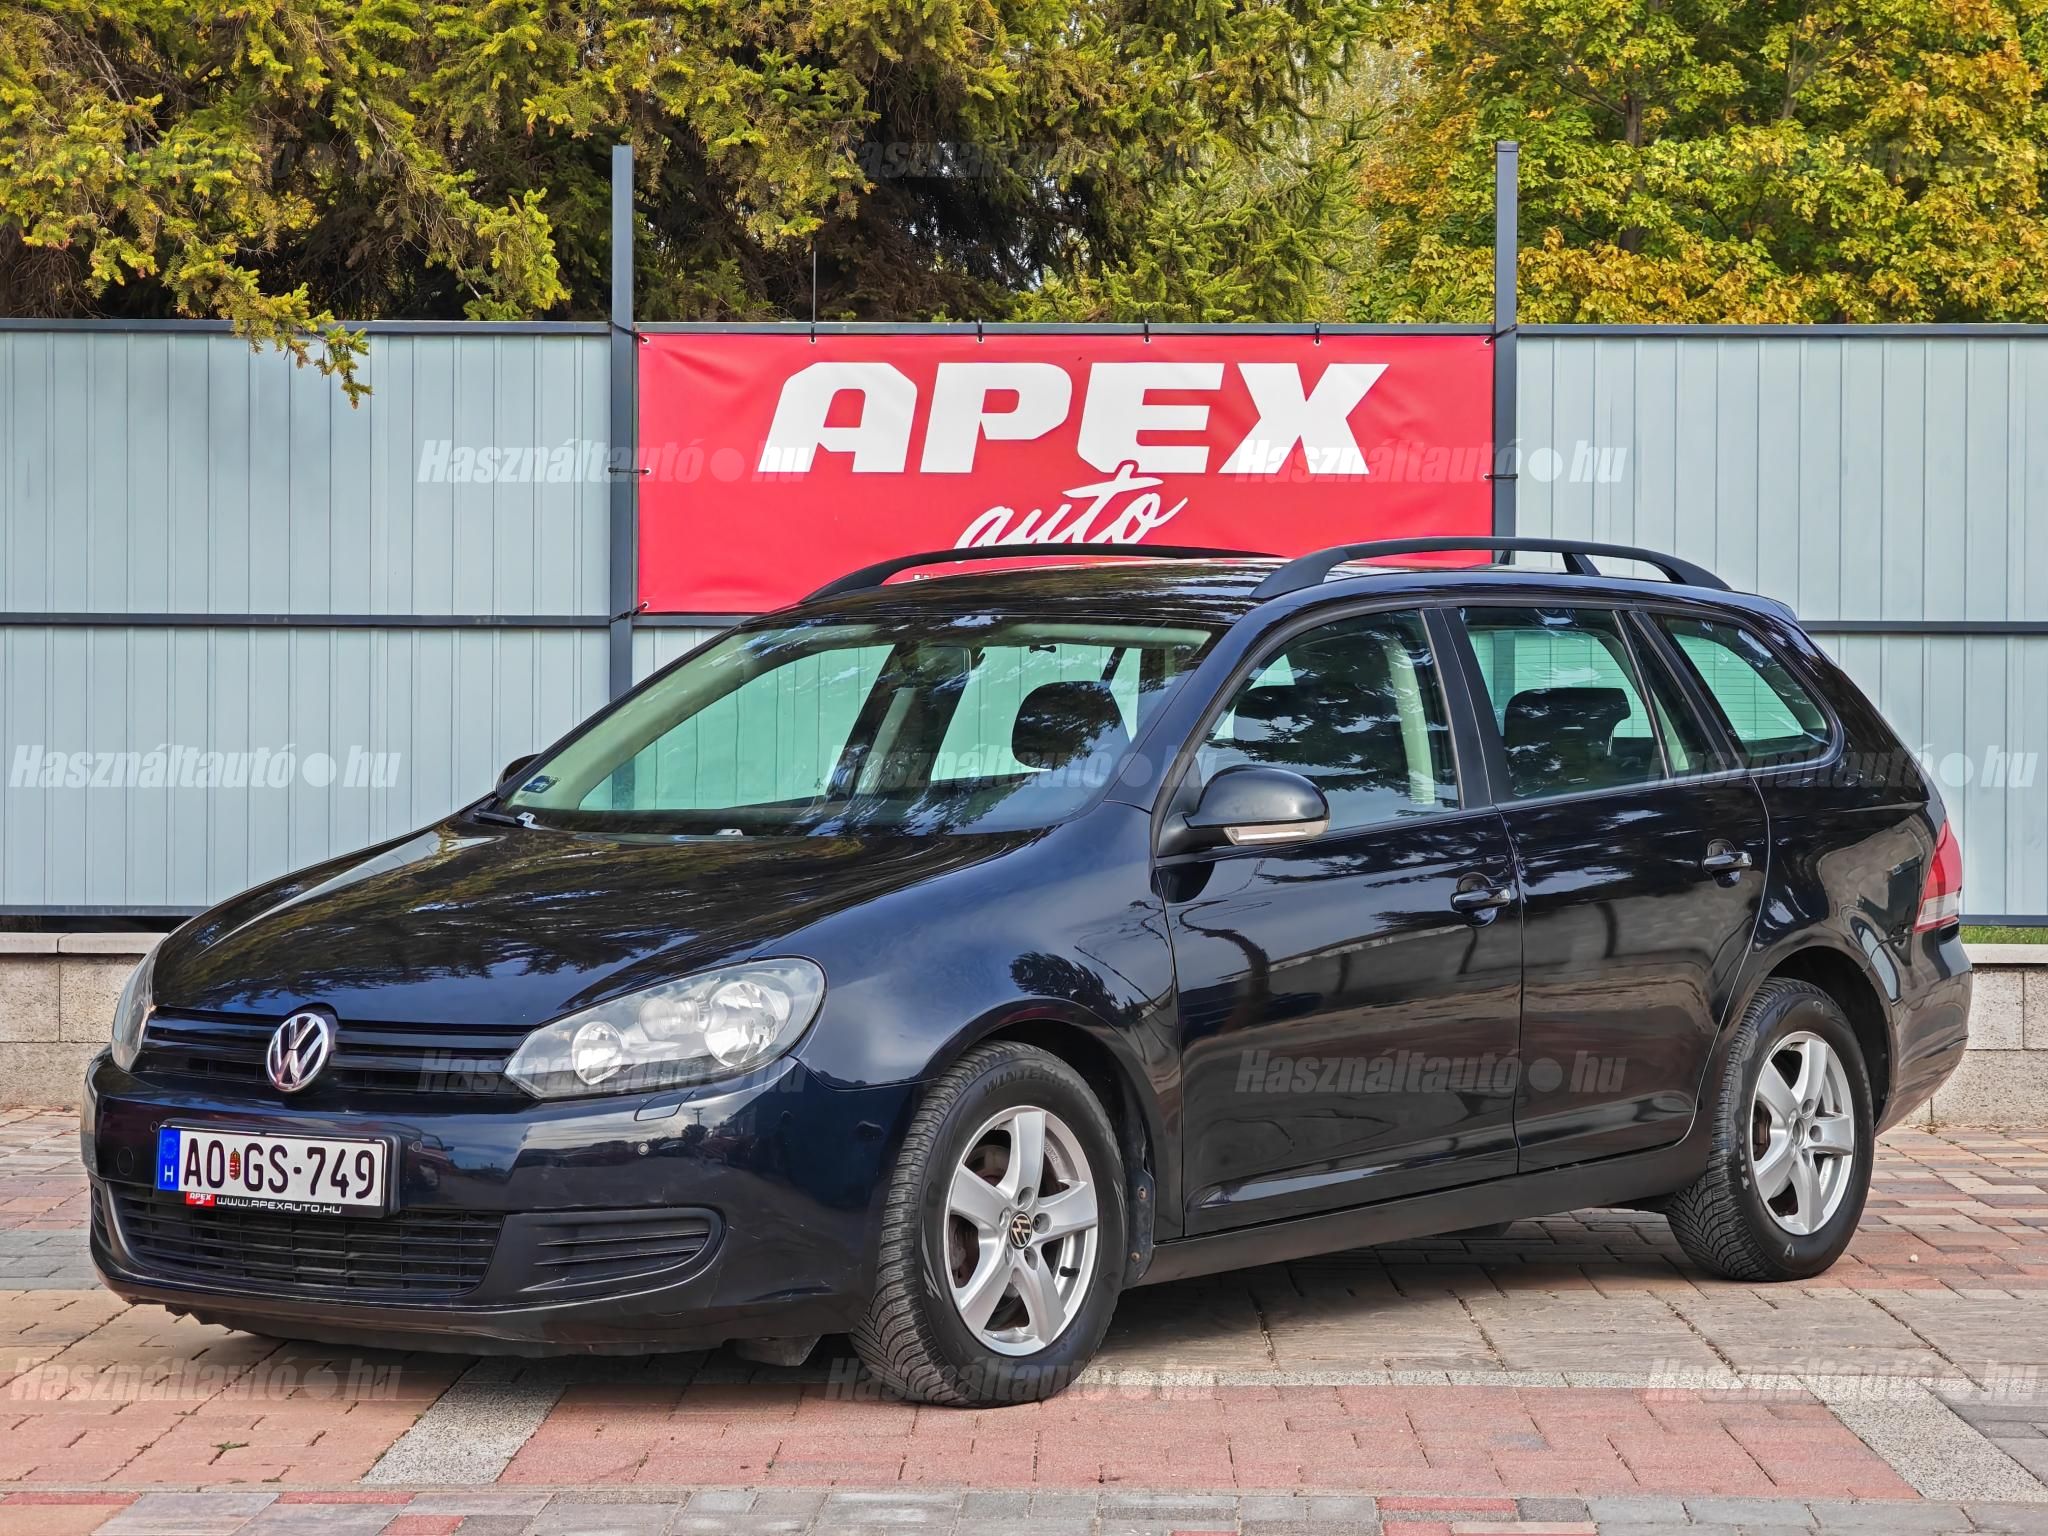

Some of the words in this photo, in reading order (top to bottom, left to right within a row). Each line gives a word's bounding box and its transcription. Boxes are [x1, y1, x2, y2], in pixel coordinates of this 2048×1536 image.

[758, 361, 1389, 474] APEX
[952, 463, 1189, 563] auto
[164, 1165, 174, 1183] H
[216, 1196, 342, 1214] WWW.APEXAUTO.HU
